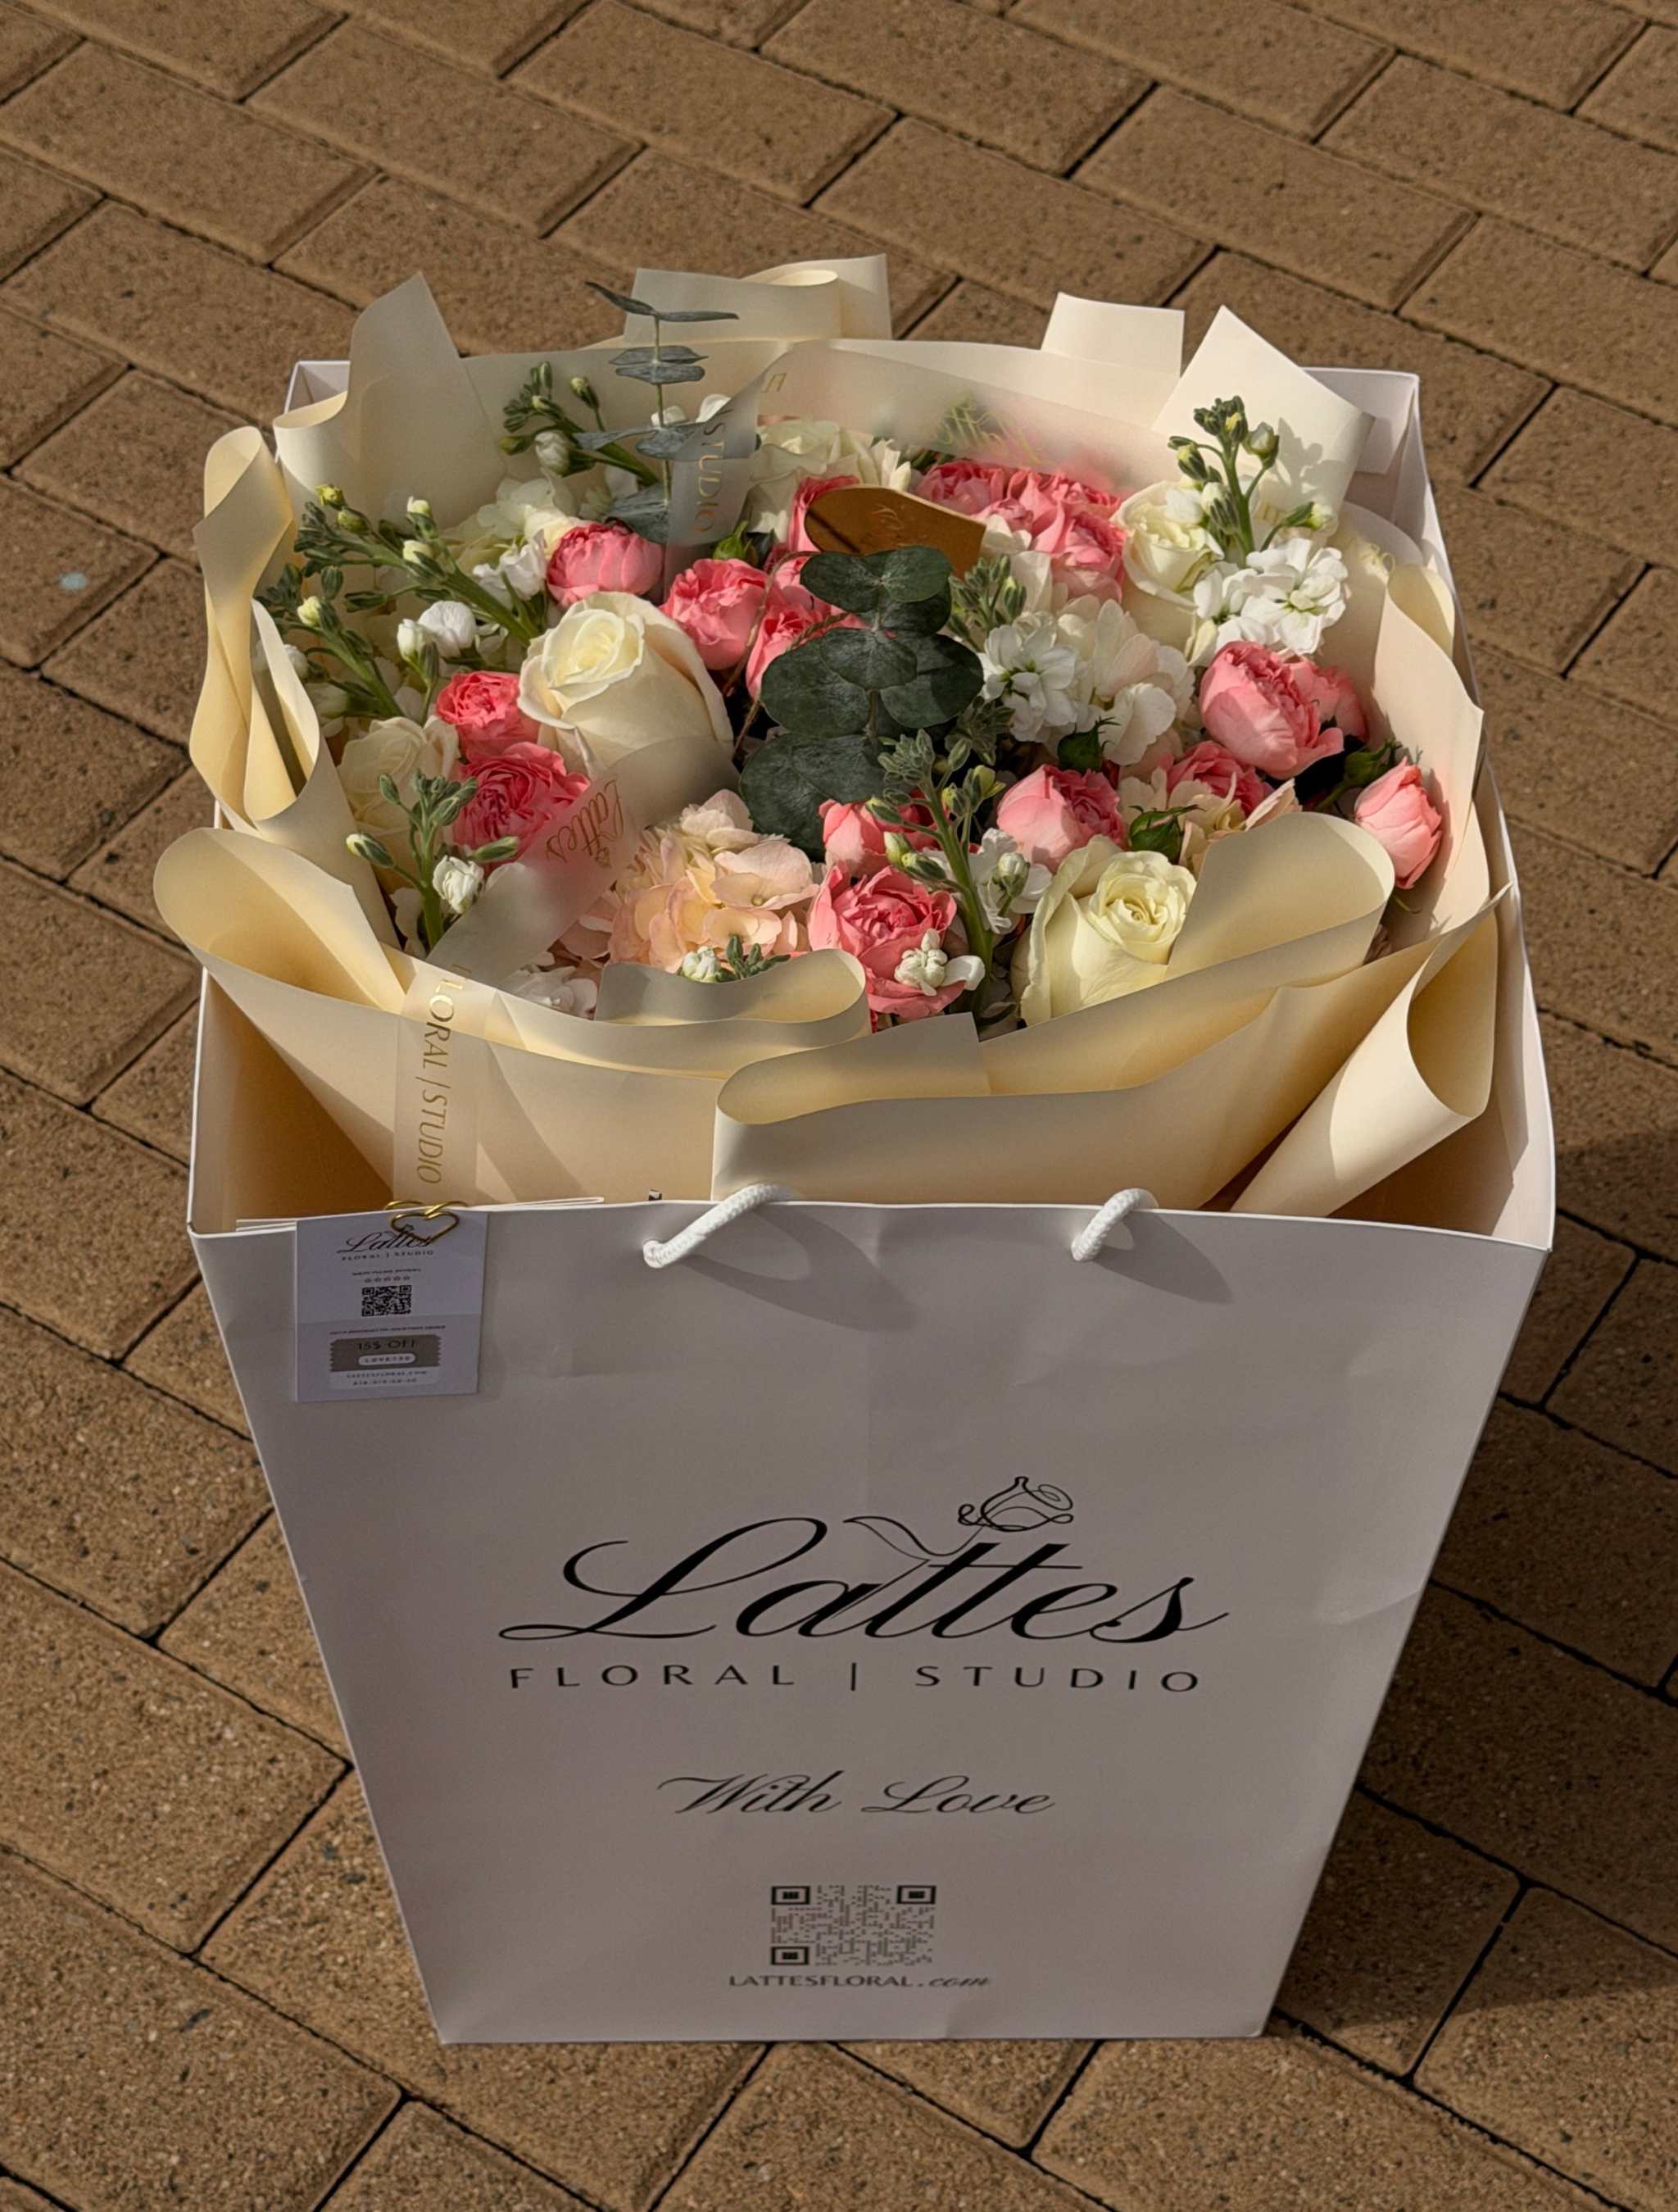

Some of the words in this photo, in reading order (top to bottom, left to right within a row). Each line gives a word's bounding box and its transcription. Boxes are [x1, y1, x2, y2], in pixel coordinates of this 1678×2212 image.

[546, 780, 624, 863] Lattes
[416, 1089, 448, 1184] STUDIO
[498, 1515, 1229, 1644] Lattes
[509, 1664, 795, 1690] FLORAL
[914, 1665, 1200, 1694] STUDIO
[657, 1769, 844, 1815] With
[860, 1774, 1055, 1815] Love
[728, 1974, 991, 1988] LATTESFLORAL.com
